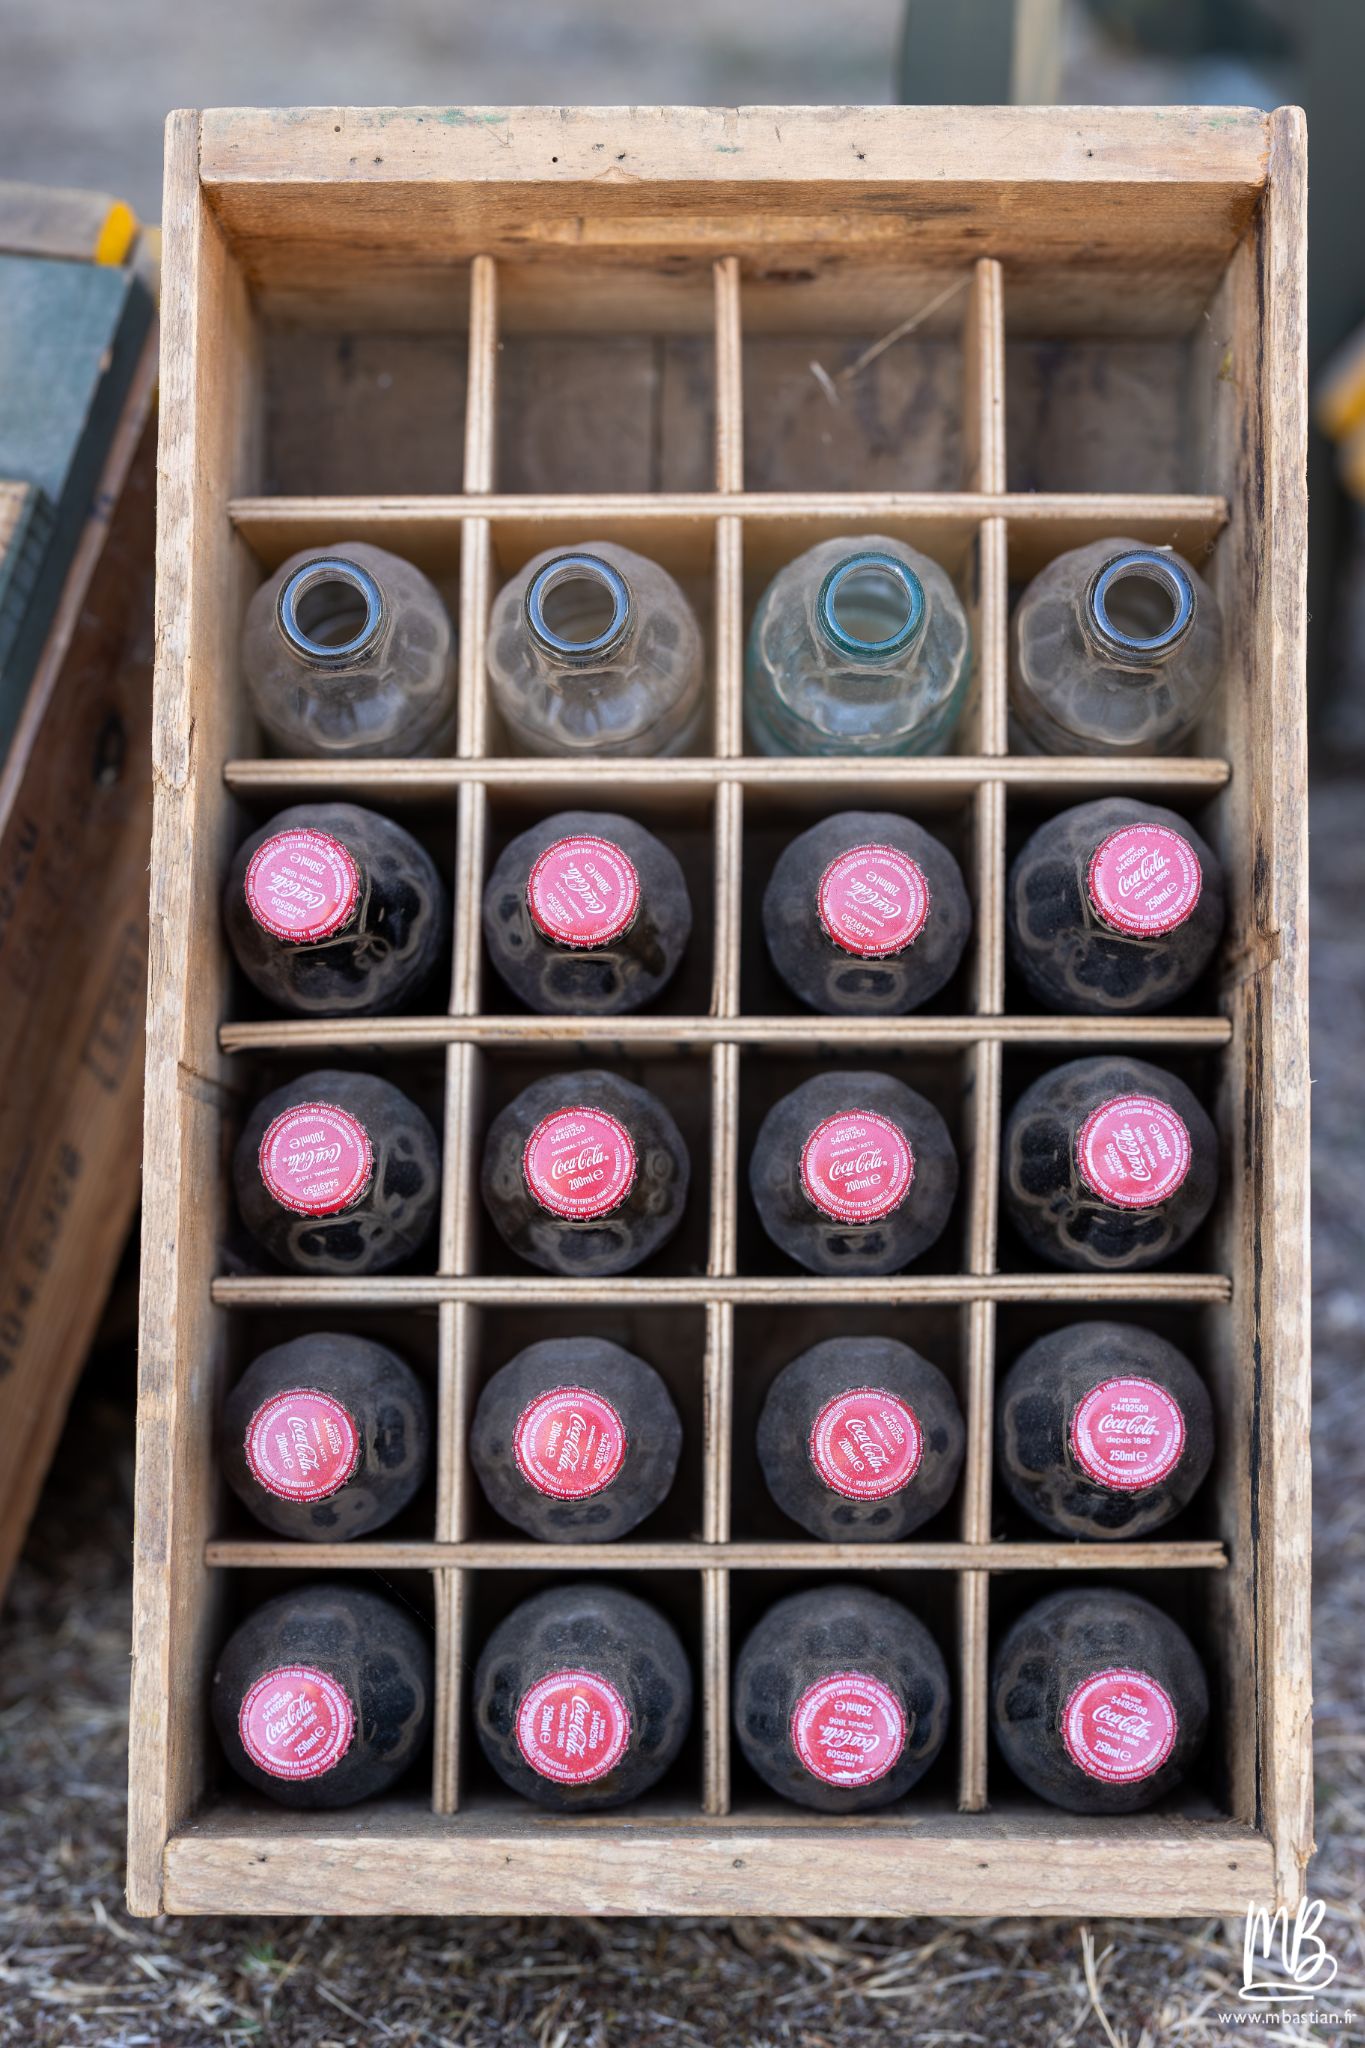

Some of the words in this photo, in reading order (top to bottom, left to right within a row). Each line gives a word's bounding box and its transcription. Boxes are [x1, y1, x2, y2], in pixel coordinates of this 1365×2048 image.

[1115, 845, 1148, 874] 54492509
[1118, 846, 1167, 897] Coca-Cola
[265, 874, 326, 909] Coca-Cola
[299, 873, 323, 888] depuis
[554, 881, 568, 897] TASTE
[558, 867, 606, 914] Coca-Cola
[1133, 881, 1156, 900] depuis
[270, 896, 307, 917] 54492509
[546, 892, 573, 924] 54491250
[566, 895, 585, 919] ORIGINAL
[843, 881, 902, 919] Coca-Cola
[844, 900, 860, 913] TASTE
[841, 912, 875, 937] 54491250
[861, 910, 885, 927] ORIGINAL
[550, 1124, 586, 1144] 54491250
[551, 1143, 577, 1156] ORIGINAL
[577, 1135, 594, 1146] TASTE
[830, 1128, 866, 1145] 54491250
[286, 1142, 341, 1175] Coca-Cola
[551, 1142, 604, 1180] Coca-Cola
[829, 1146, 856, 1157] ORIGINAL
[856, 1140, 874, 1149] TASTE
[1105, 1142, 1127, 1179] 54492509
[1111, 1127, 1151, 1181] Coca-Cola
[1143, 1143, 1157, 1168] depuis
[312, 1166, 340, 1177] ORIGINAL
[828, 1147, 883, 1181] Coca-Cola
[295, 1174, 312, 1183] TASTE
[302, 1178, 339, 1195] 54491250
[1110, 1402, 1149, 1412] 54492509
[322, 1417, 340, 1454] 54491250
[867, 1414, 884, 1439] ORIGINAL
[883, 1438, 896, 1455] TASTE
[879, 1410, 904, 1444] 54491250
[1097, 1413, 1160, 1435] Coca-Cola
[286, 1416, 320, 1471] Coca-Cola
[310, 1417, 322, 1444] ORIGINAL
[318, 1444, 328, 1462] TASTE
[558, 1413, 587, 1474] Coca-Cola
[585, 1424, 596, 1451] ORIGINAL
[593, 1432, 609, 1469] 54491250
[844, 1418, 891, 1468] Coca-Cola
[1105, 1436, 1132, 1444] depuis
[580, 1453, 589, 1470] TASTE
[261, 1690, 293, 1721] 54492509
[265, 1691, 313, 1745] Coca-Cola
[558, 1702, 568, 1728] depuis
[1110, 1695, 1148, 1715] 54492509
[566, 1695, 590, 1759] Coca-Cola
[588, 1710, 601, 1749] 54492509
[848, 1720, 874, 1730] depuis
[1091, 1704, 1155, 1738] Coca-Cola
[1095, 1726, 1120, 1740] depuis
[282, 1727, 303, 1747] depuis
[817, 1726, 880, 1753] Coca-Cola
[826, 1749, 864, 1763] 54492509
